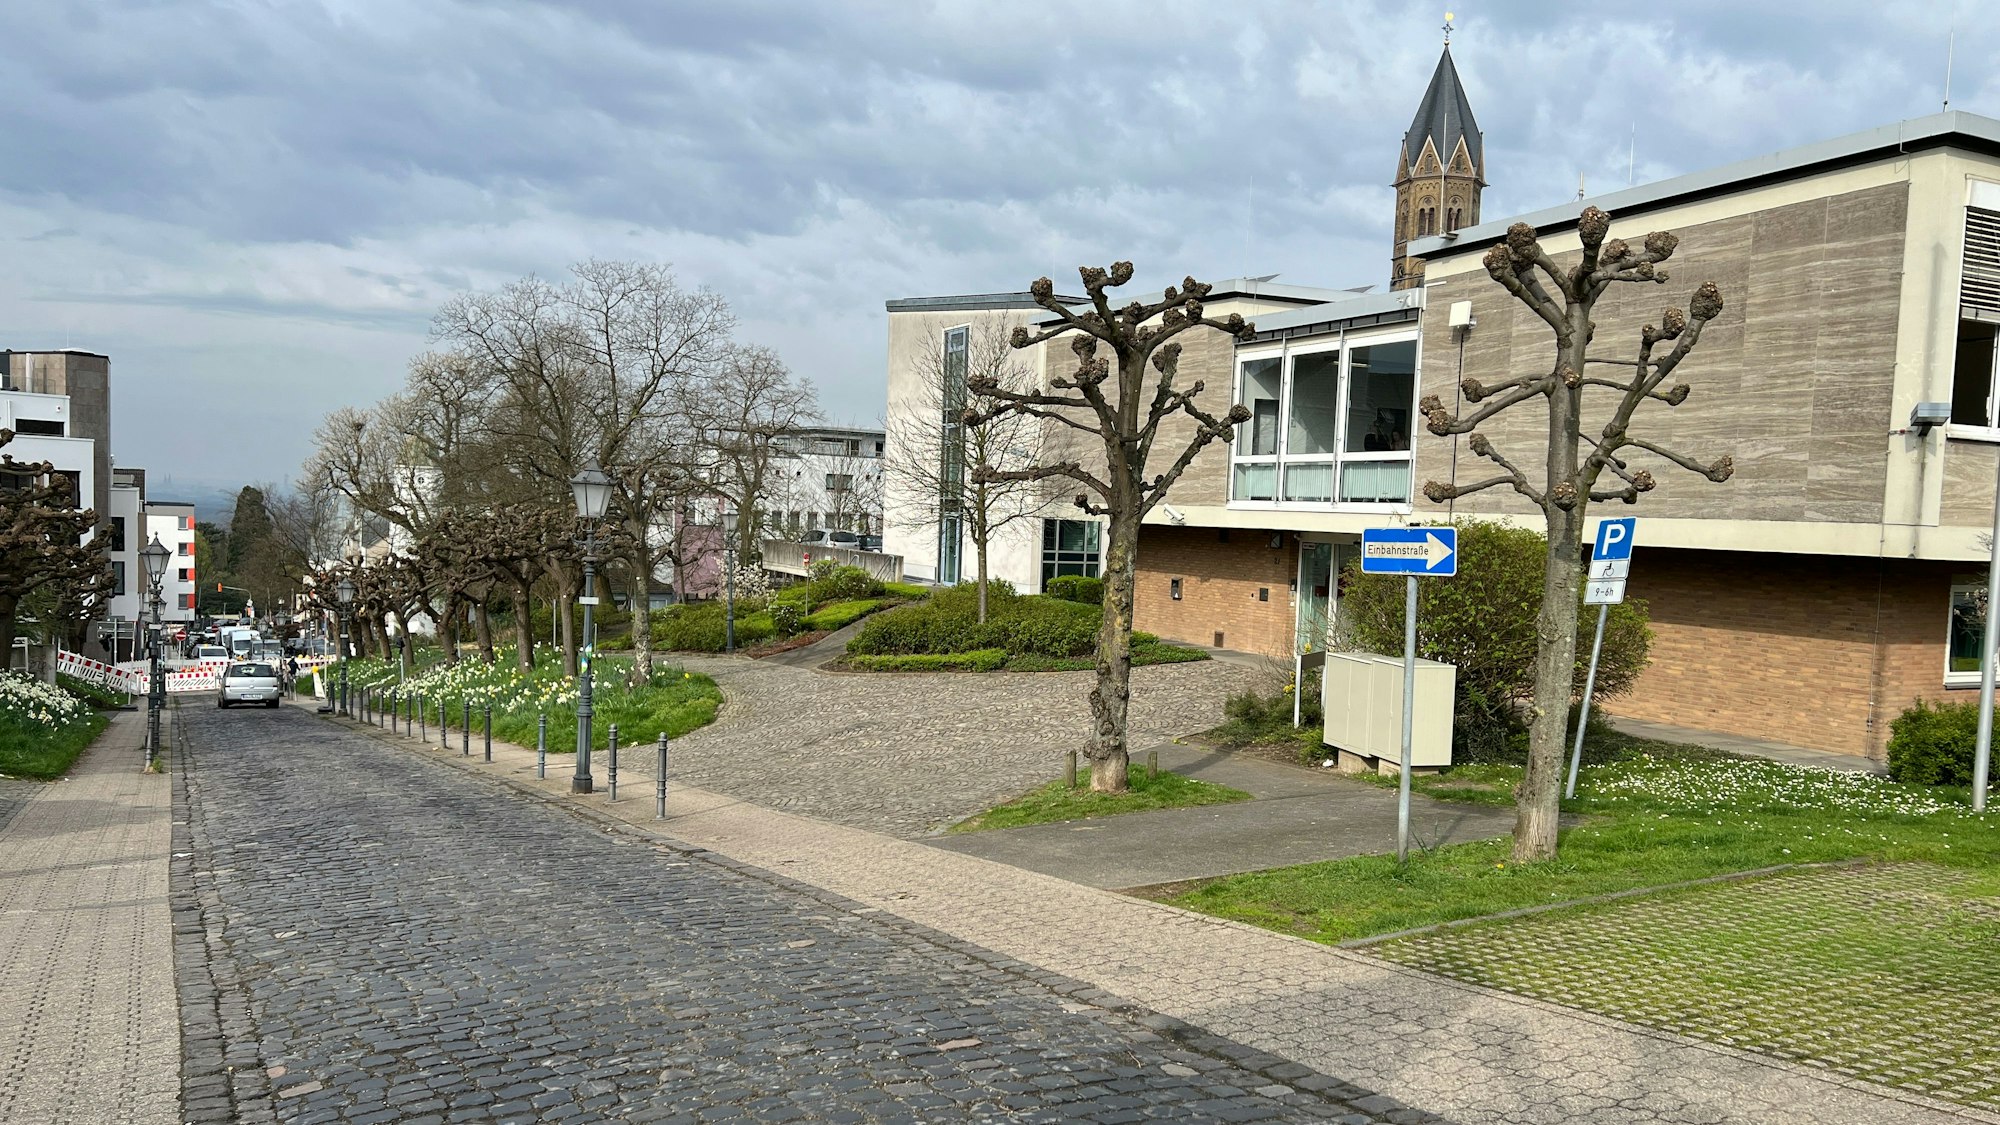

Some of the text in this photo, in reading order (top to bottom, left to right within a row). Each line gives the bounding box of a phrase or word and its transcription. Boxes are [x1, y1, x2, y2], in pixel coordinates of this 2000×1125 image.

[1602, 523, 1626, 556] P
[1367, 544, 1429, 556] Einbahnstraße
[1595, 586, 1614, 597] 9-6h
